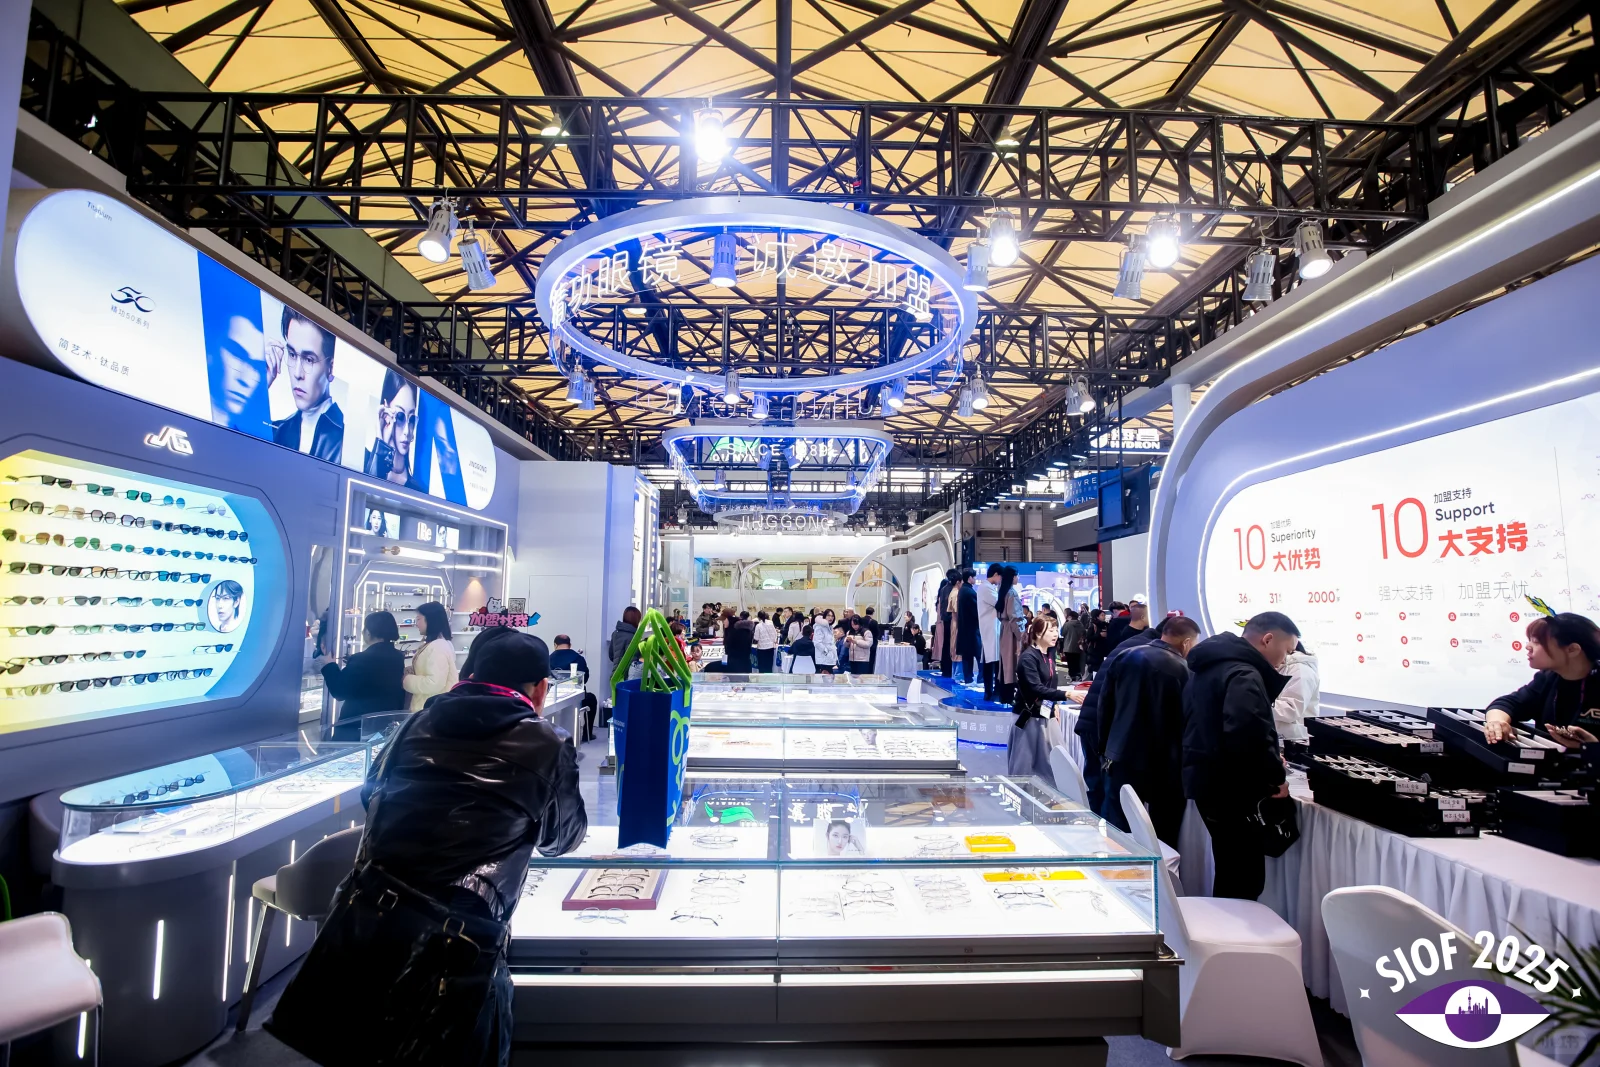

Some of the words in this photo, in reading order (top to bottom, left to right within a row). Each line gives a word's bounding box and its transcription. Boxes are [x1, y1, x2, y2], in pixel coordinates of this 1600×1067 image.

[87, 200, 113, 222] Titanium
[747, 232, 932, 316] 诚邀加盟
[110, 304, 150, 330] 精功50系列
[727, 443, 780, 456] SINCE
[1110, 441, 1160, 449] HYDRON
[1433, 487, 1472, 504] 加盟支持
[1435, 501, 1496, 522] Support
[1270, 527, 1316, 544] Superiority
[1371, 497, 1429, 560] 10
[1438, 521, 1529, 558] 大支持
[1233, 524, 1266, 571] 10
[1272, 547, 1321, 573] 大优势
[1378, 584, 1434, 601] 强大支持
[1458, 580, 1529, 600] 加盟无忧
